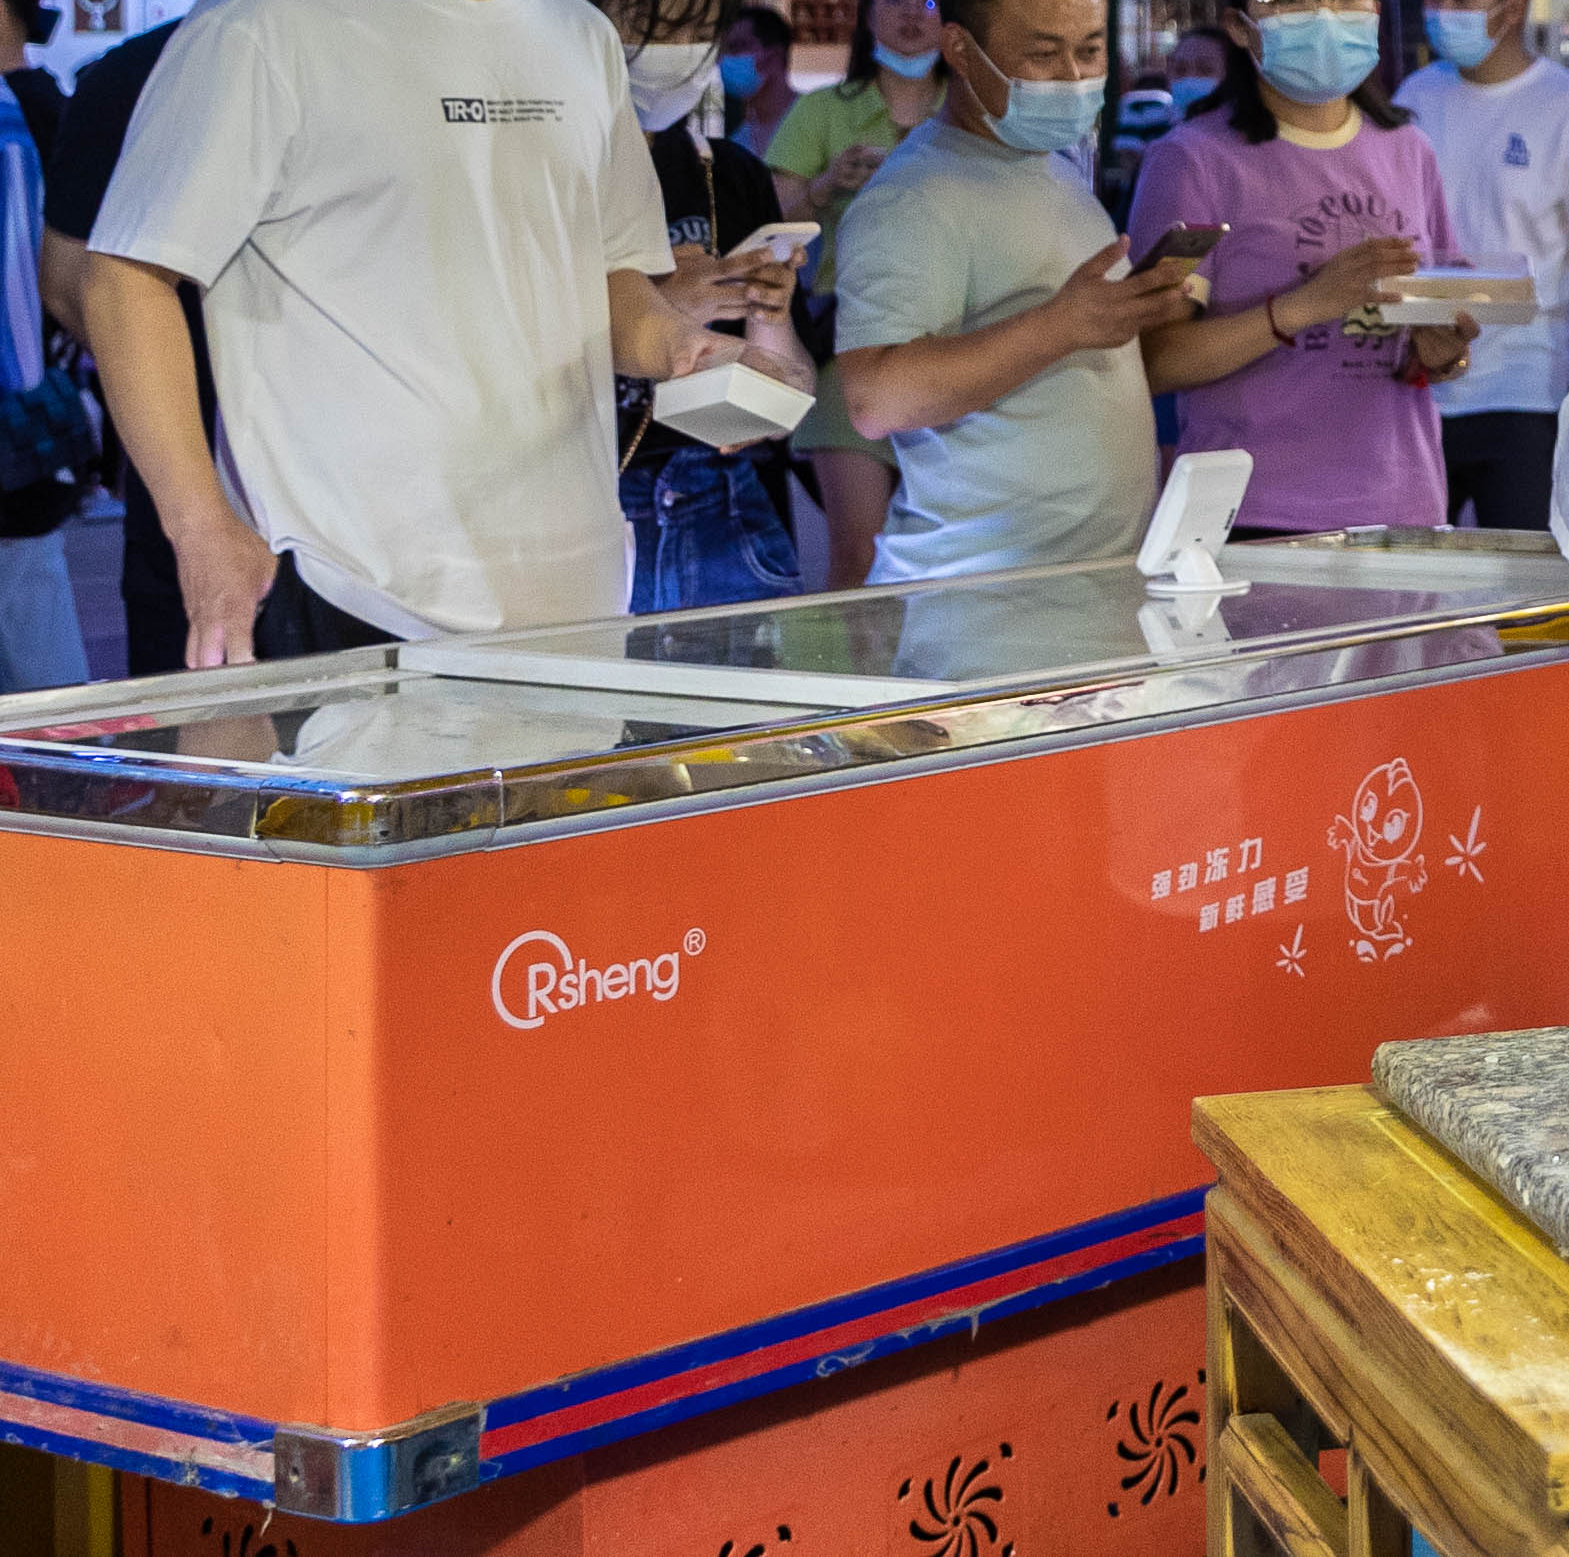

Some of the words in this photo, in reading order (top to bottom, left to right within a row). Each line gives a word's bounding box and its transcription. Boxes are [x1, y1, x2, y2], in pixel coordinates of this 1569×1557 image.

[1151, 837, 1263, 901] 强劲冻力
[1199, 866, 1309, 933] 新鲜感受
